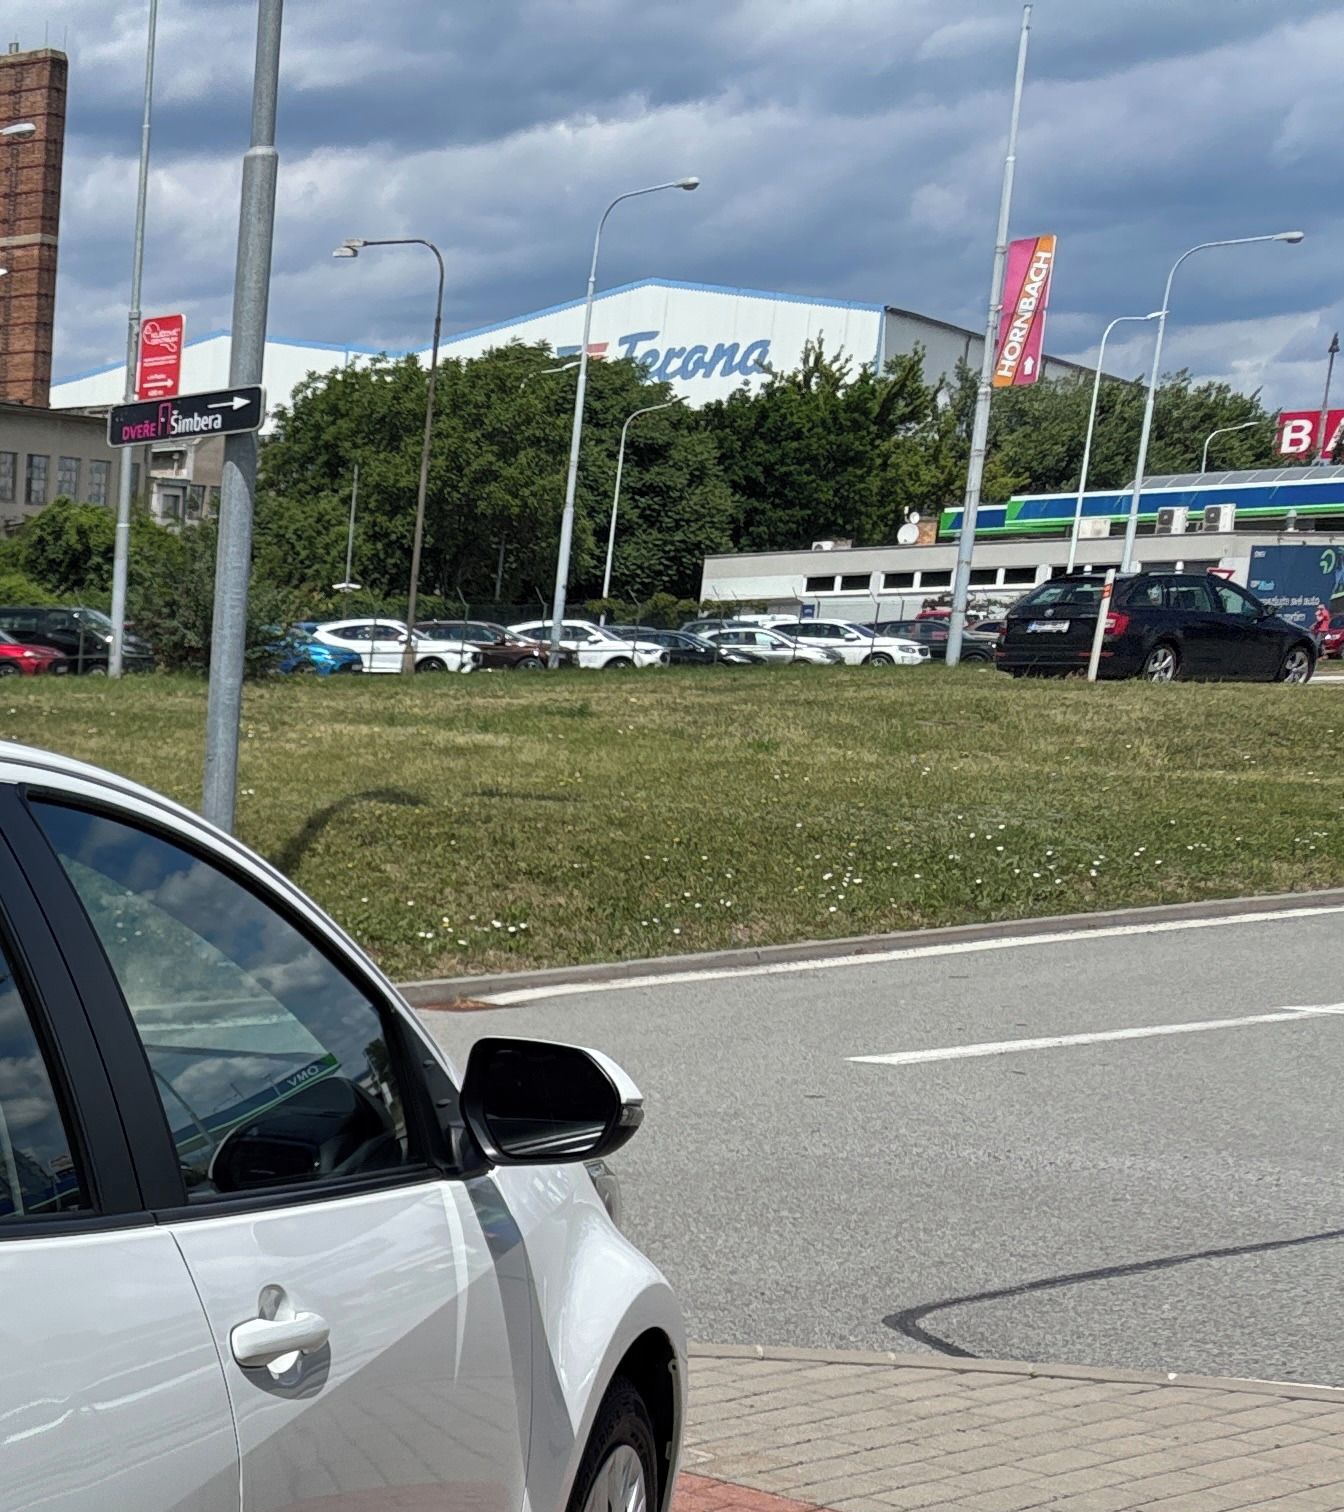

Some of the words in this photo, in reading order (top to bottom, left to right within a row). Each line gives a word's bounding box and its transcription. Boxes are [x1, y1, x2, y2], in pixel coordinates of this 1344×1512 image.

[997, 251, 1052, 377] HORNBACH
[122, 420, 157, 440] DVEŘE
[170, 410, 223, 435] Šimbera
